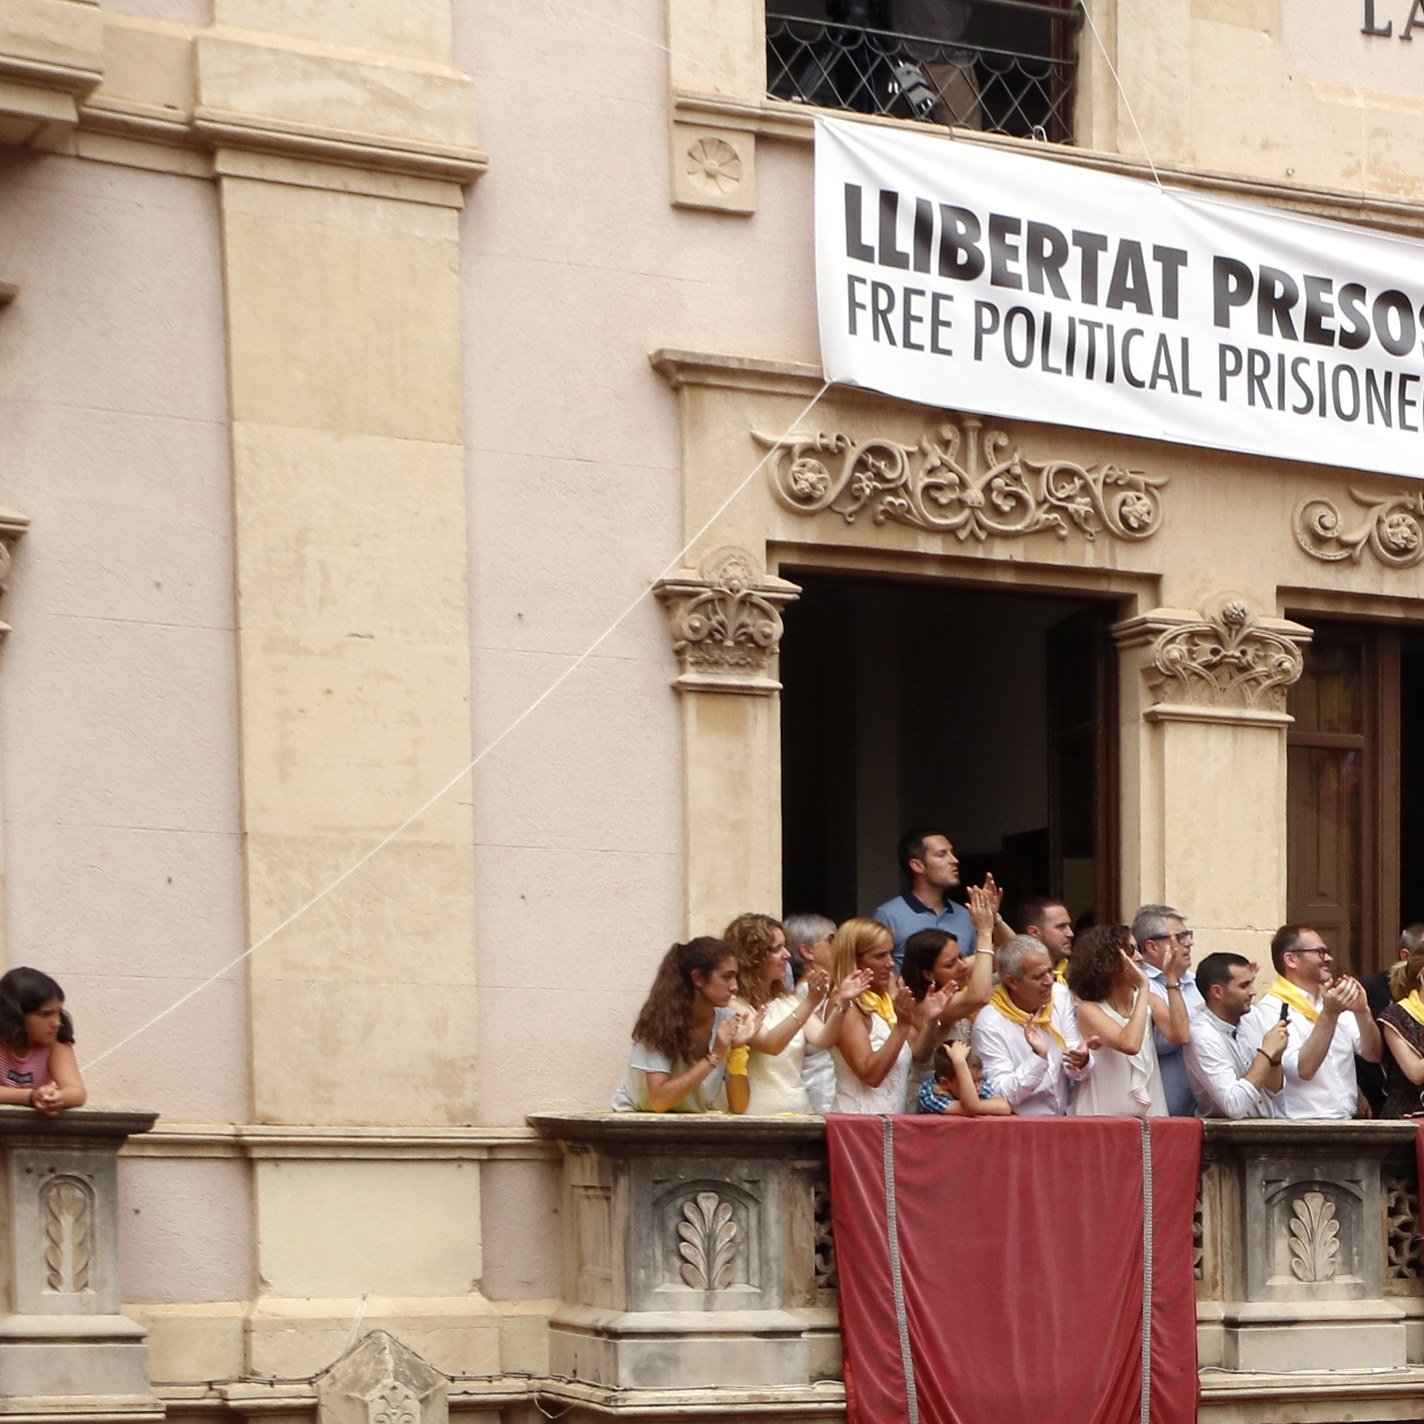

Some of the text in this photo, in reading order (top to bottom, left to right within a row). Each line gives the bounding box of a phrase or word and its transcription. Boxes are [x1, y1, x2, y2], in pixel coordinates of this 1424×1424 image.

[844, 182, 1188, 319] LLIBERTAT
[847, 275, 954, 357] FREE
[974, 300, 1202, 398] POLITICAL
